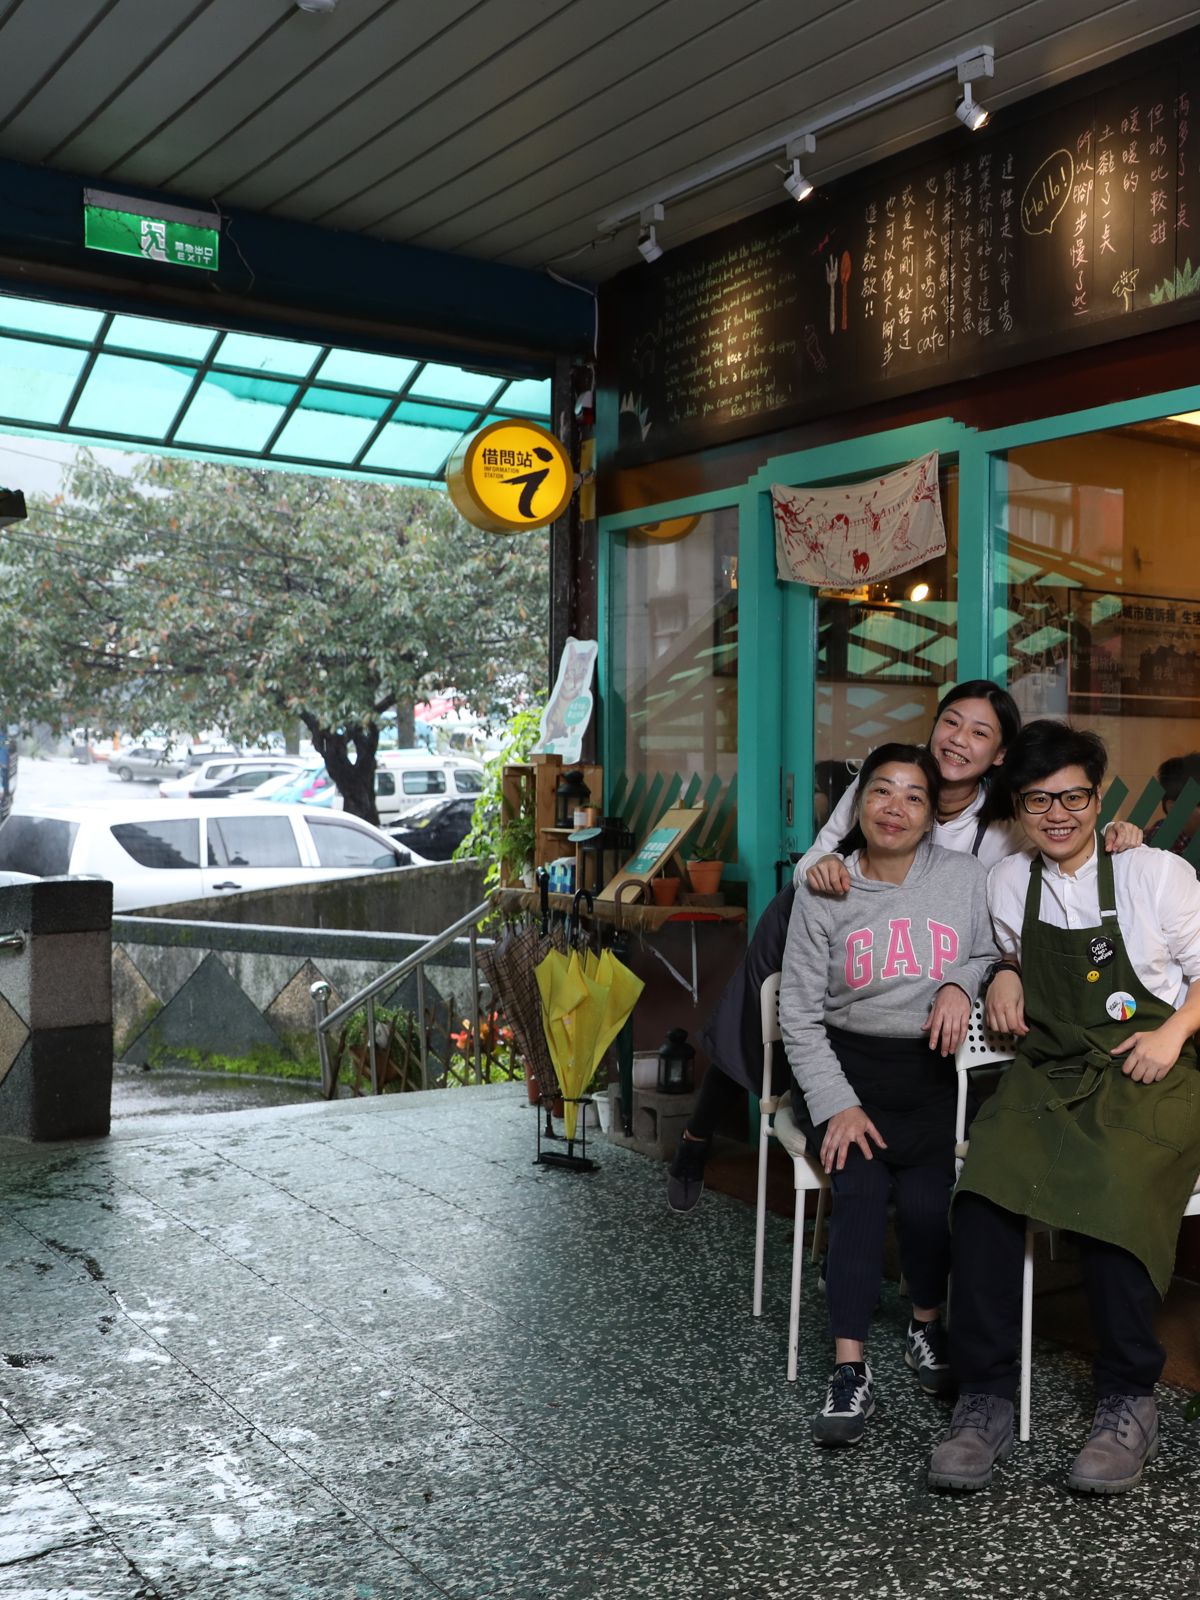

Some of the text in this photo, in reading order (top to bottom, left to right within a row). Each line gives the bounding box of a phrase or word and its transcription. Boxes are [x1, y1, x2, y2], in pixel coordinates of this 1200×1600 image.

[1024, 166, 1068, 226] Hello!
[177, 252, 211, 264] EXIT
[482, 448, 533, 468] 借問站
[484, 465, 519, 474] INFORMATION
[843, 917, 960, 991] GAP
